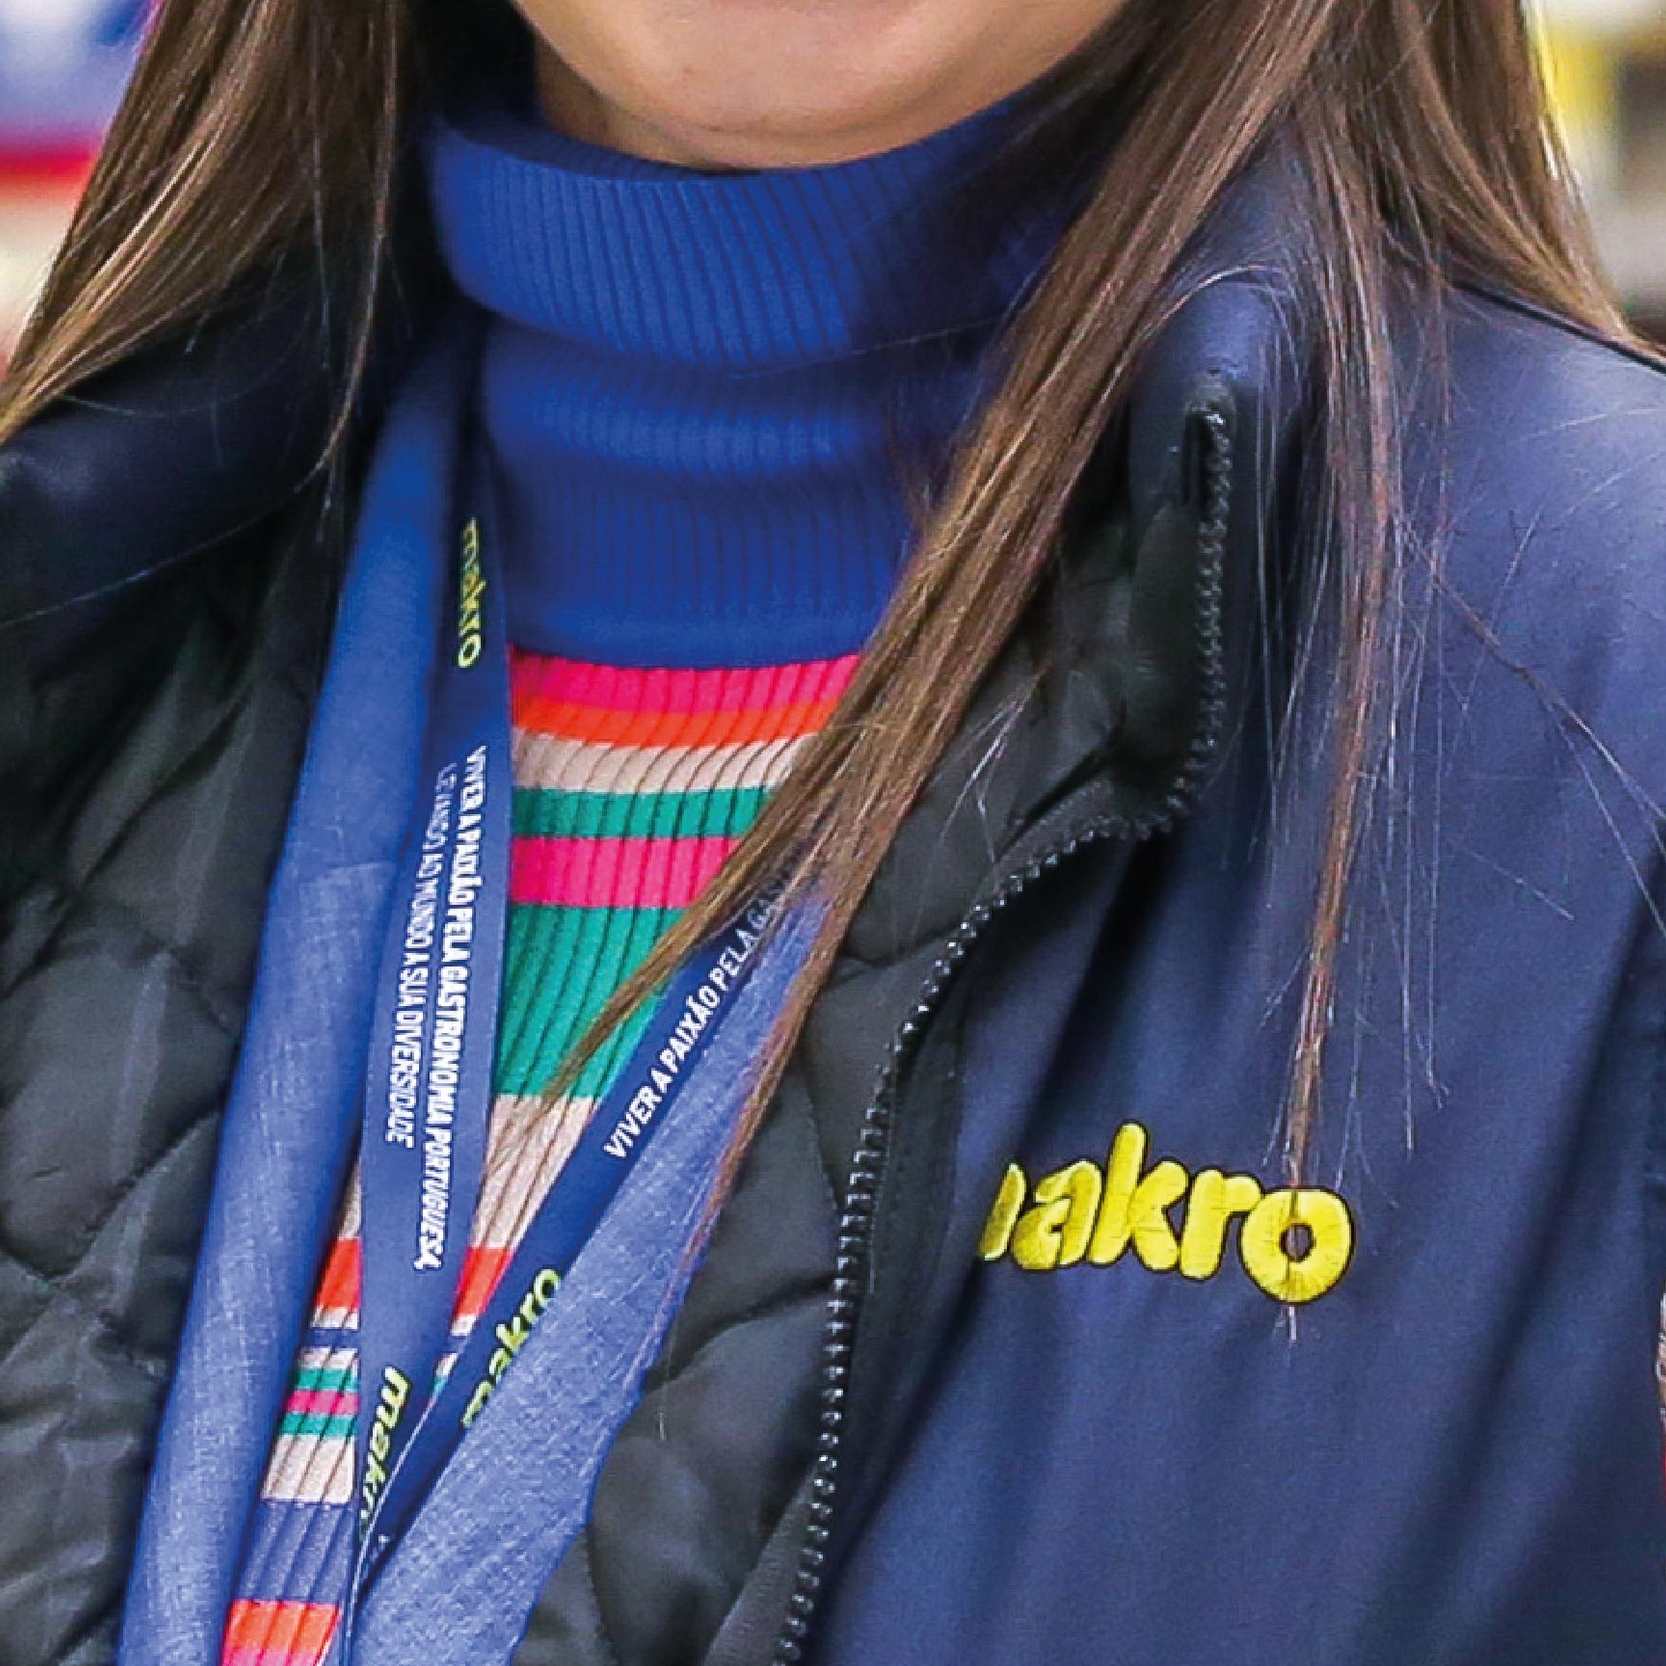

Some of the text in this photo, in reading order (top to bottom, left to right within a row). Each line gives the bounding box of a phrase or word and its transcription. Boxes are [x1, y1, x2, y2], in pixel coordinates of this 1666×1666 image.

[459, 745, 487, 813] VIVER
[404, 878, 439, 949] MUNDO
[441, 906, 473, 962] PELA
[398, 966, 430, 1007] SUA
[403, 952, 430, 965] A
[425, 965, 469, 1125] GASTRONOMIA
[603, 928, 759, 1159] VIVER A PAIXÃO PELA
[386, 1010, 424, 1148] DIVERSIDADE
